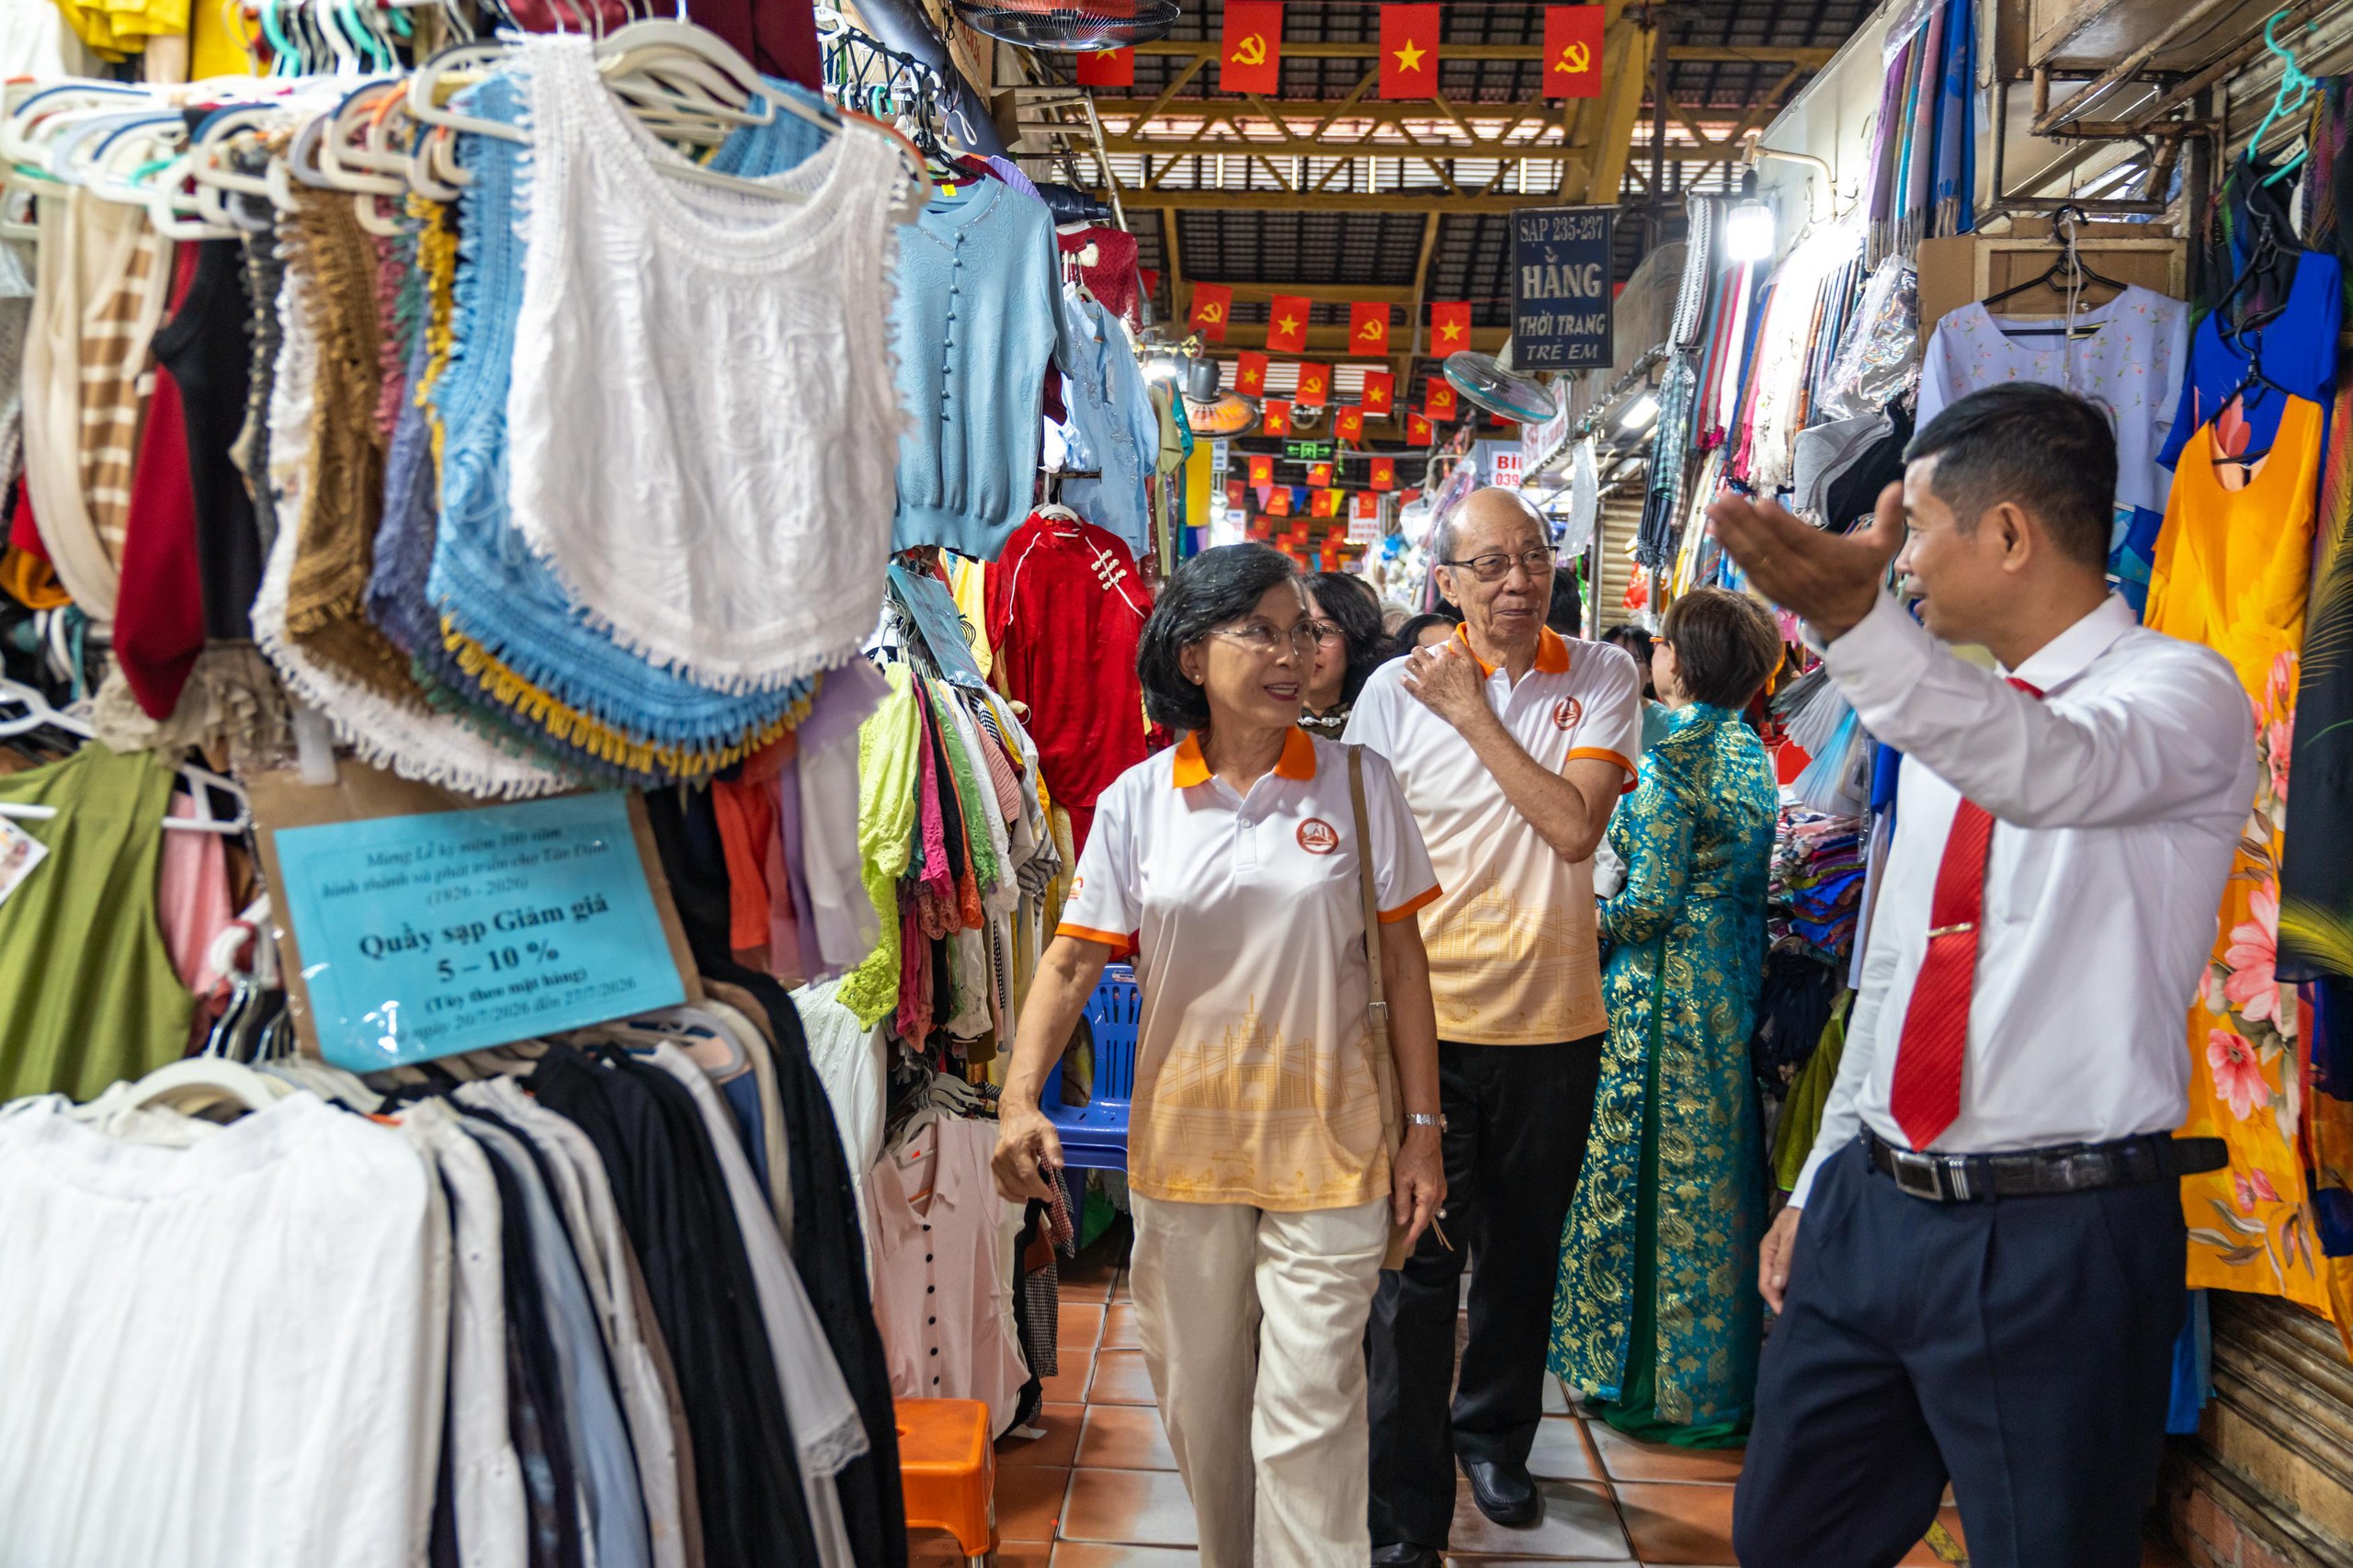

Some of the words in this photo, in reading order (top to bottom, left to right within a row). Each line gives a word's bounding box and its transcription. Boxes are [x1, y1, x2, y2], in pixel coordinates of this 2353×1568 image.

[1520, 218, 1549, 247] SẠP
[1552, 216, 1604, 241] 235-237
[1522, 245, 1603, 299] HẰNG
[1518, 309, 1553, 336] THỜI
[1557, 313, 1606, 335] TRANG
[1527, 338, 1563, 360] TRẺ
[1568, 344, 1598, 359] EM
[359, 921, 432, 961] Quầy
[441, 920, 487, 946] sạp
[493, 903, 565, 933] Giảm
[571, 892, 609, 924] giá
[437, 958, 456, 984] 5
[488, 946, 520, 972] 10
[526, 937, 559, 964] %
